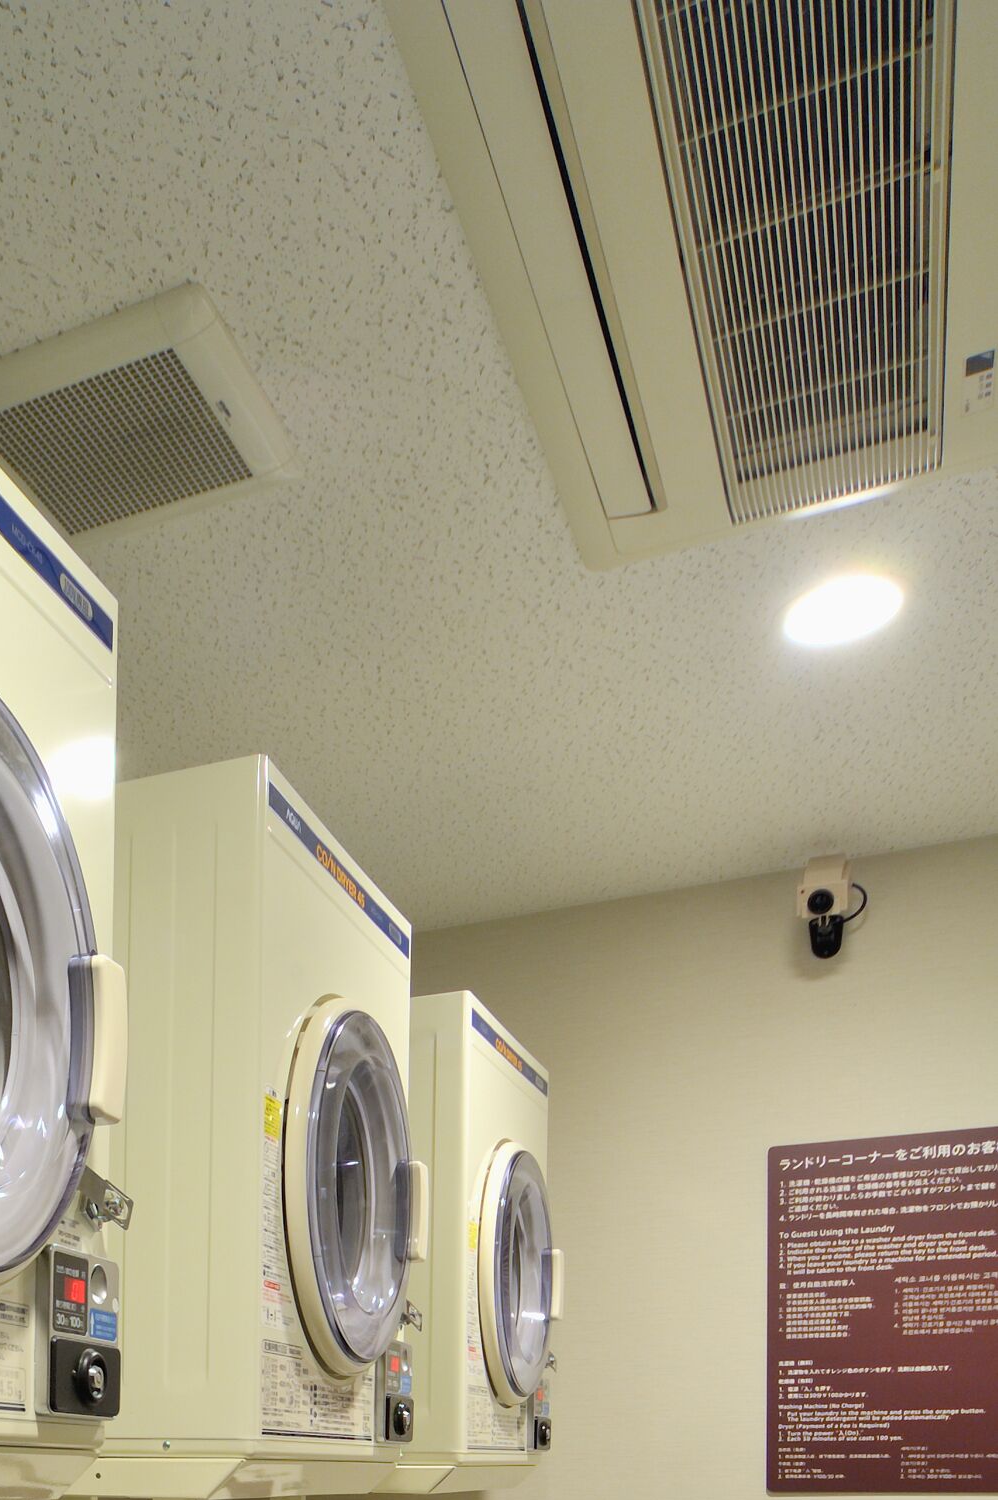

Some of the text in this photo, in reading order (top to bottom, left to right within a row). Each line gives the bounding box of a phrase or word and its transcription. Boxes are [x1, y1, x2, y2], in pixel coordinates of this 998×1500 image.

[337, 869, 357, 899] DRYER
[357, 892, 365, 908] 45
[779, 1140, 998, 1171] ランドリーコーナーをご利用のお客
[779, 1224, 895, 1239] To Guests Using the Laundry
[906, 1234, 925, 1242] dryer
[959, 1230, 977, 1238] front
[918, 1241, 937, 1249] dryer
[793, 1262, 806, 1270] you
[937, 1252, 972, 1260] extended
[854, 1251, 876, 1259] please
[857, 1264, 875, 1272] front
[935, 1408, 959, 1416] orange
